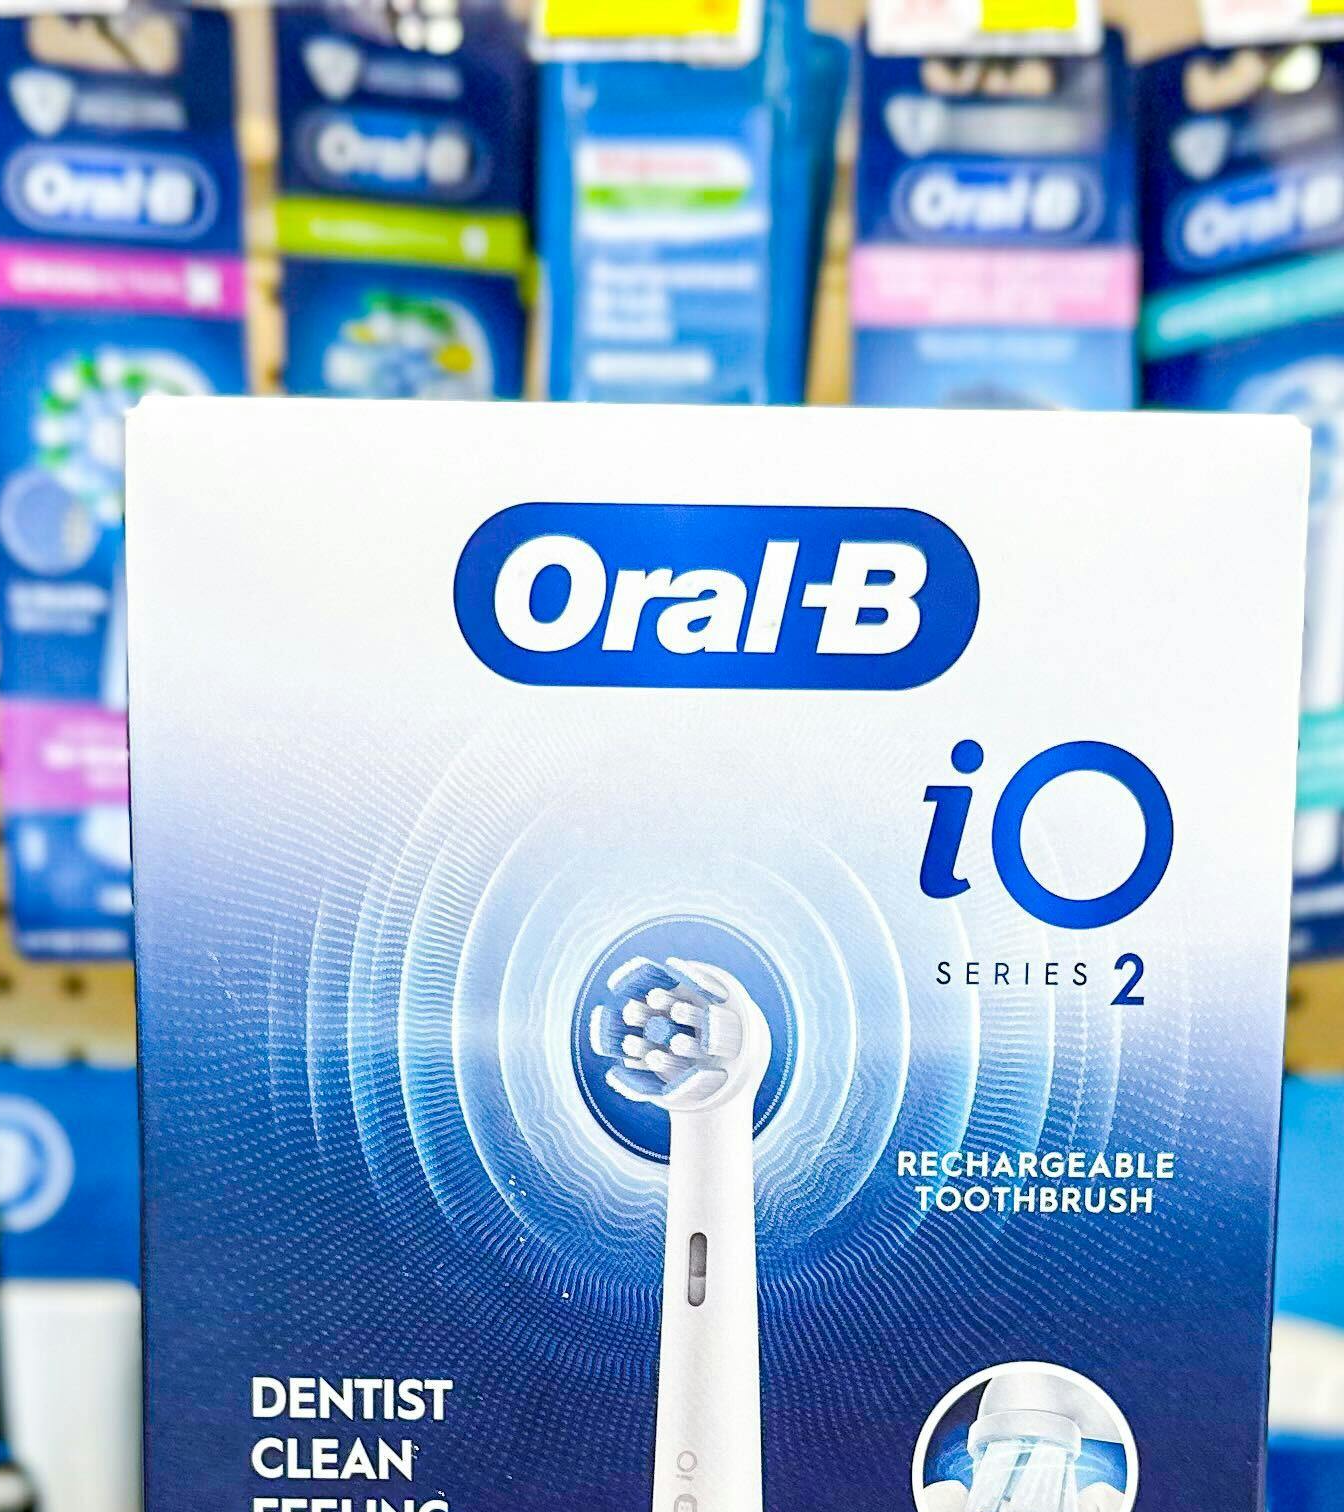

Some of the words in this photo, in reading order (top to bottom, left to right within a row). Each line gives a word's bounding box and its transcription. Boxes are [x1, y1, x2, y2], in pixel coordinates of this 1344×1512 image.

[494, 533, 930, 655] Oral-B
[919, 739, 1174, 930] iO
[935, 961, 1088, 987] SERIES
[1110, 952, 1145, 1006] 2
[897, 1150, 1175, 1179] RECHARGEABLE
[914, 1185, 1154, 1214] TOOTHBRUSH
[252, 1376, 453, 1421] DENTIST
[250, 1436, 413, 1482] CLEAN
